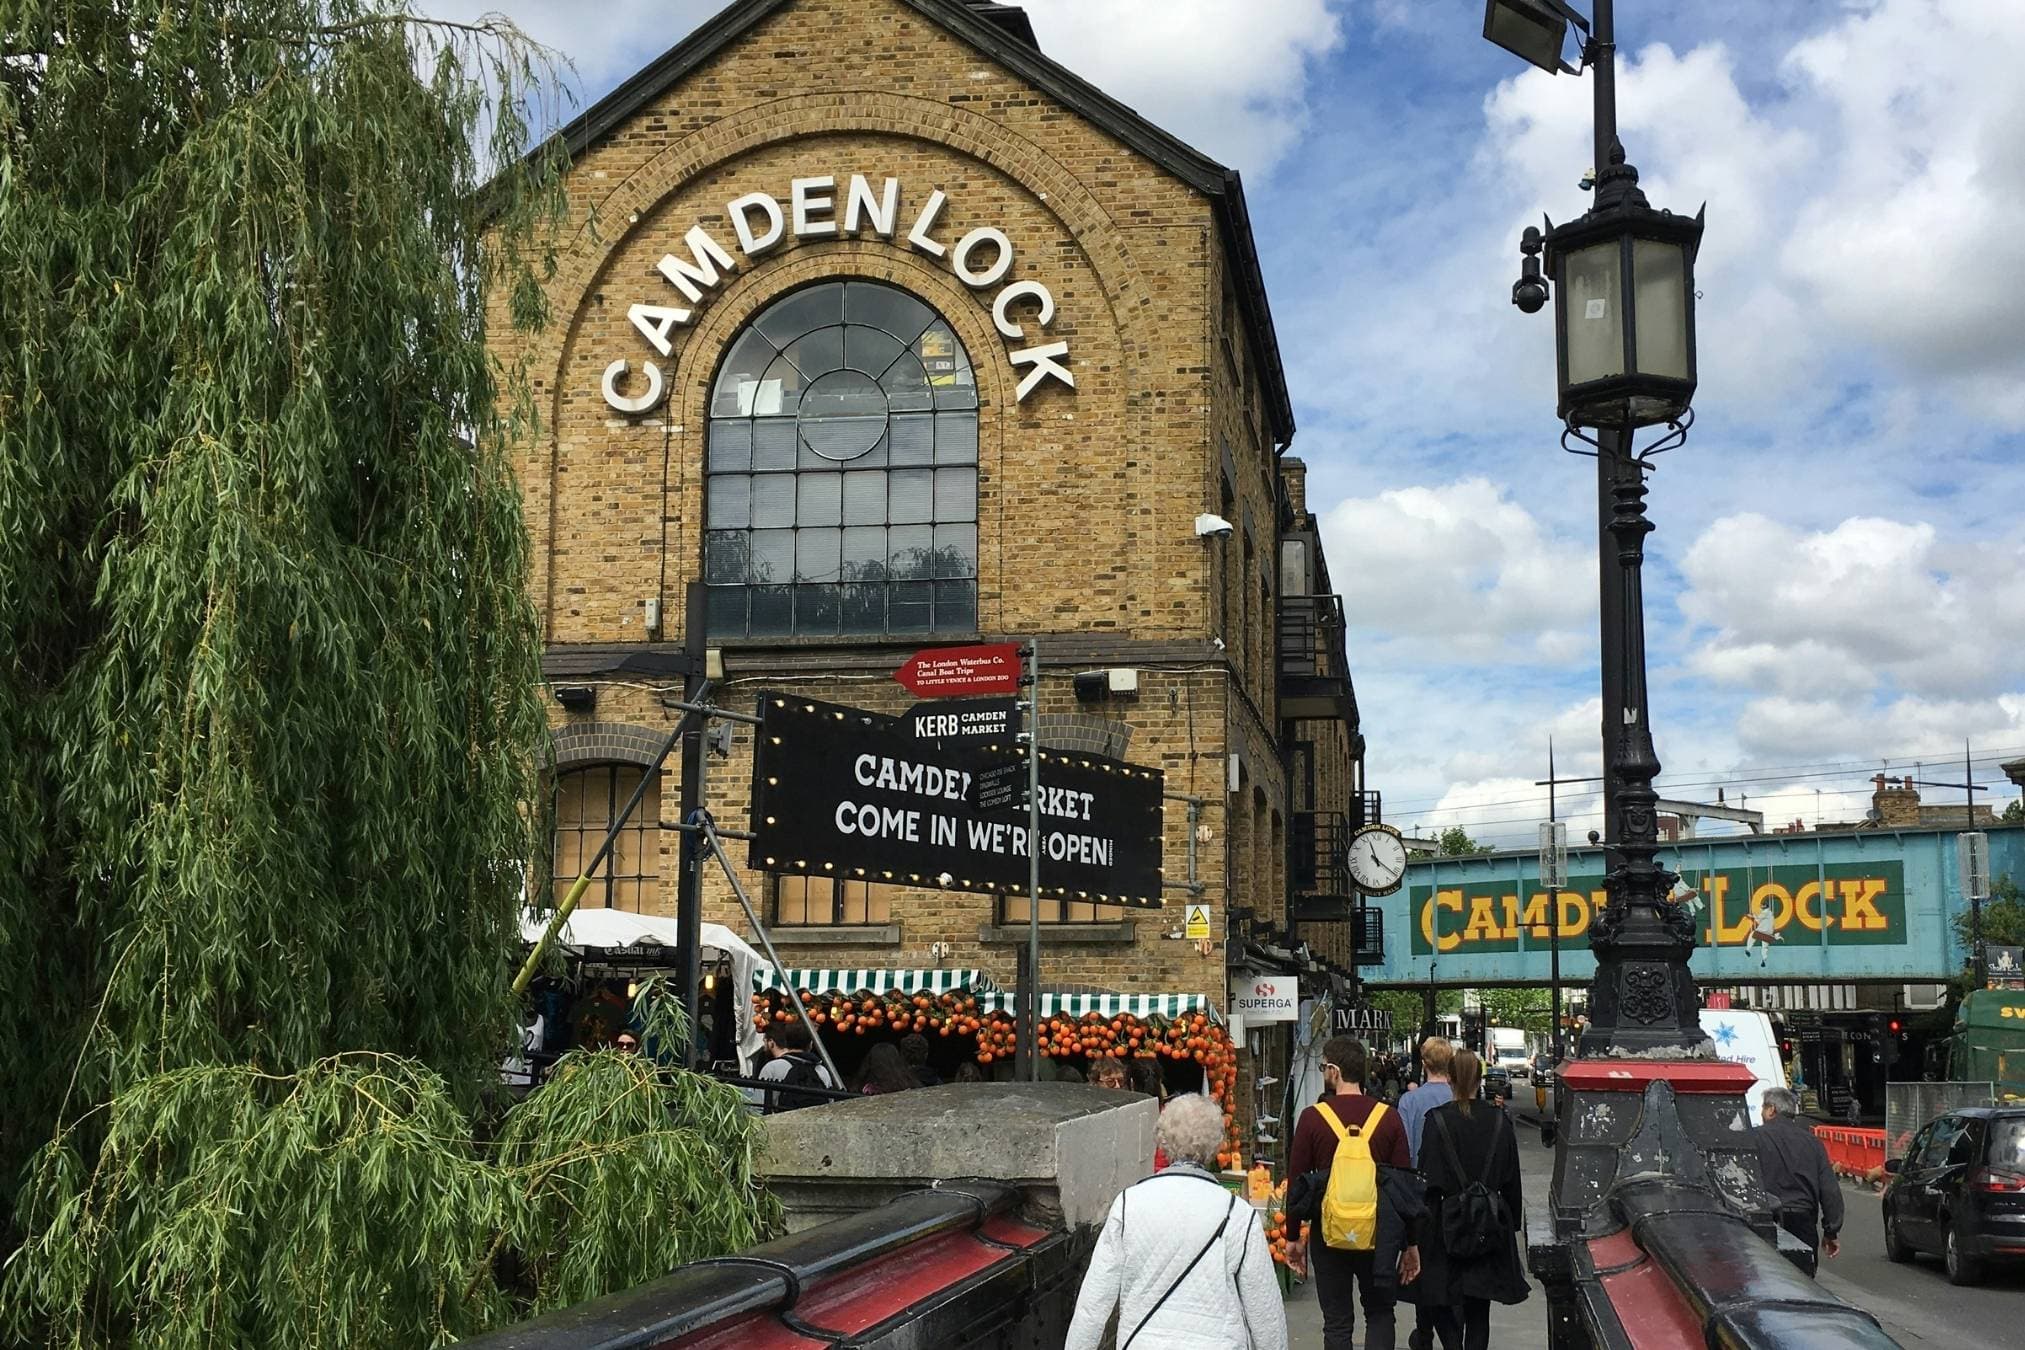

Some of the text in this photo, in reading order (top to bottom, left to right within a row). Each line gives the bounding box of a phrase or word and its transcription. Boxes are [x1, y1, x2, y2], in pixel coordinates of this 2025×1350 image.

[601, 174, 1076, 415] CAMDEN LOCK
[917, 656, 1004, 669] The London Waterbus Co.
[940, 668, 954, 676] Boat
[956, 667, 974, 675] Trips
[961, 711, 1007, 723] CAMDEN
[915, 714, 958, 738] KERB
[961, 724, 1006, 735] MARKET
[835, 800, 920, 842] COME
[930, 814, 957, 847] IN
[1048, 831, 1107, 866] OPEN
[1354, 824, 1399, 836] CAMDEN LOCK
[1704, 876, 1888, 944] LOCK
[1239, 999, 1292, 1008] SUPERGA
[1736, 1055, 1756, 1063] Hire
